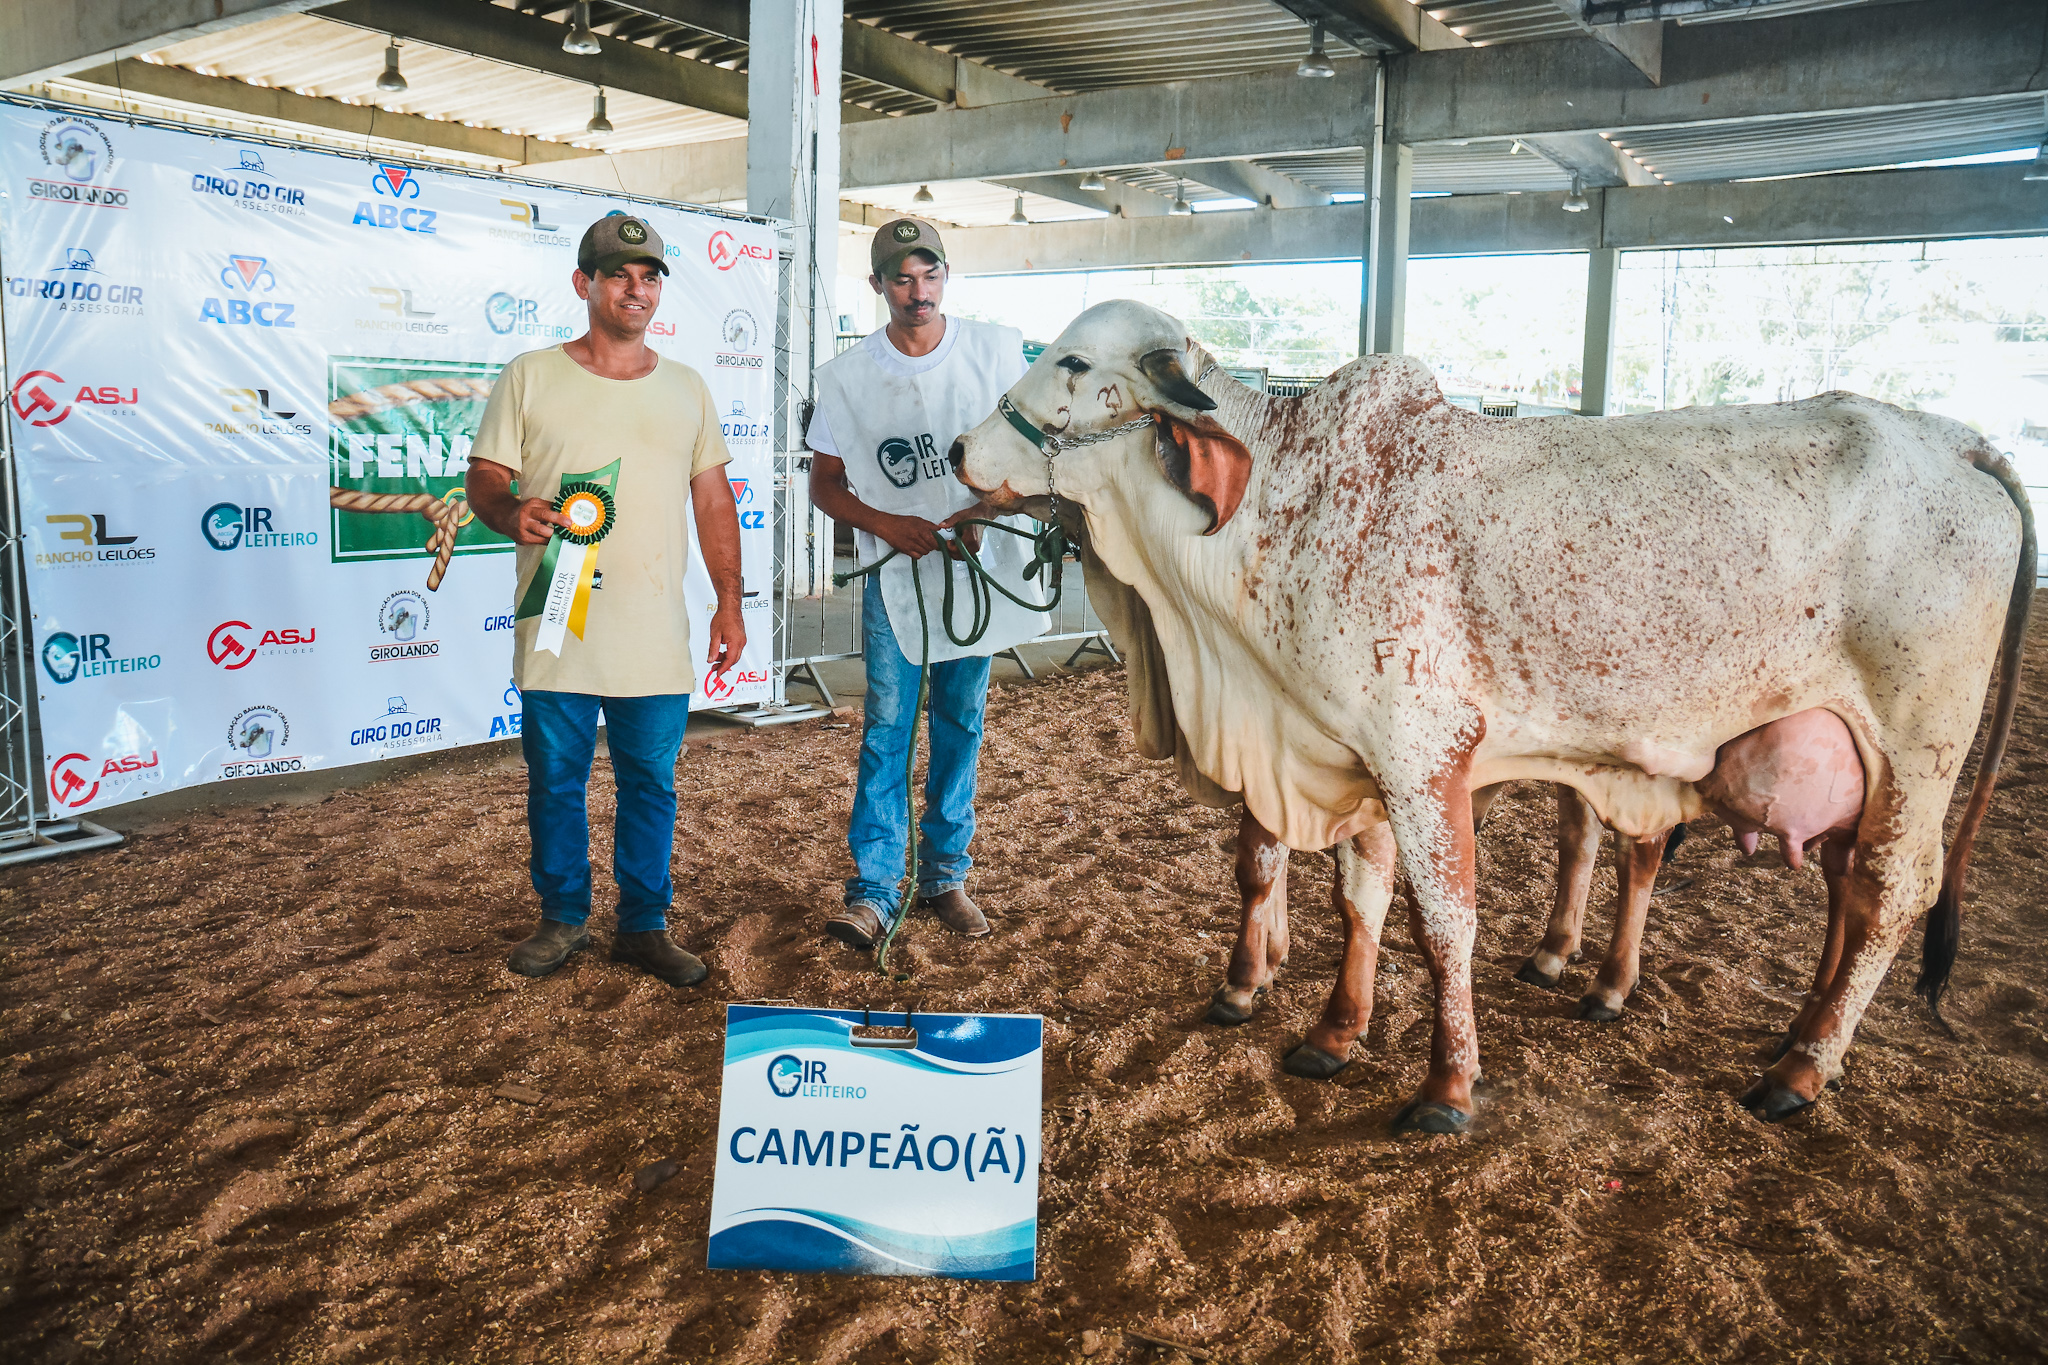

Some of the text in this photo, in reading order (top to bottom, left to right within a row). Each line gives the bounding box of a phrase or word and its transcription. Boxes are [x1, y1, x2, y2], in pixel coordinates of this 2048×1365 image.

[30, 182, 128, 206] GIROLANDO
[191, 174, 305, 206] GIRO DO GIR
[233, 200, 306, 216] ASSESSORIA
[352, 201, 437, 234] ABCZ
[489, 228, 531, 242] RANCHO
[533, 233, 571, 247] LEILÕES
[624, 226, 643, 238] VAZ
[738, 244, 772, 260] ASJ
[9, 278, 143, 305] GIRO DO GIR
[59, 302, 144, 316] ASSESSORIA
[198, 297, 296, 328] ABCZ
[354, 319, 448, 334] RANCHO LEILÕES
[518, 323, 573, 339] LEITEIRO
[716, 354, 763, 367] GIROLANDO
[75, 386, 138, 404] ASJ
[733, 423, 748, 437] DO
[349, 433, 472, 478] FENA
[922, 457, 954, 480] LEIT
[737, 511, 765, 529] CZ
[46, 514, 139, 546] RL
[245, 532, 318, 547] LEITEIRO
[36, 547, 156, 565] RANCHO LEILÕES
[548, 572, 569, 624] MELHOR
[259, 628, 315, 646] ASJ
[371, 643, 439, 660] GIROLANDO
[83, 654, 161, 678] LEITEIRO
[736, 670, 767, 684] ASJ
[350, 718, 441, 746] GIRO DO GIR
[489, 713, 522, 738] AB
[383, 733, 443, 749] ASSESSORIA
[101, 750, 158, 777] ASJ
[224, 759, 301, 778] GIROLANDO
[803, 1085, 867, 1099] LEITEIRO
[729, 1123, 1027, 1184] CAMPEÃO(Ã)
